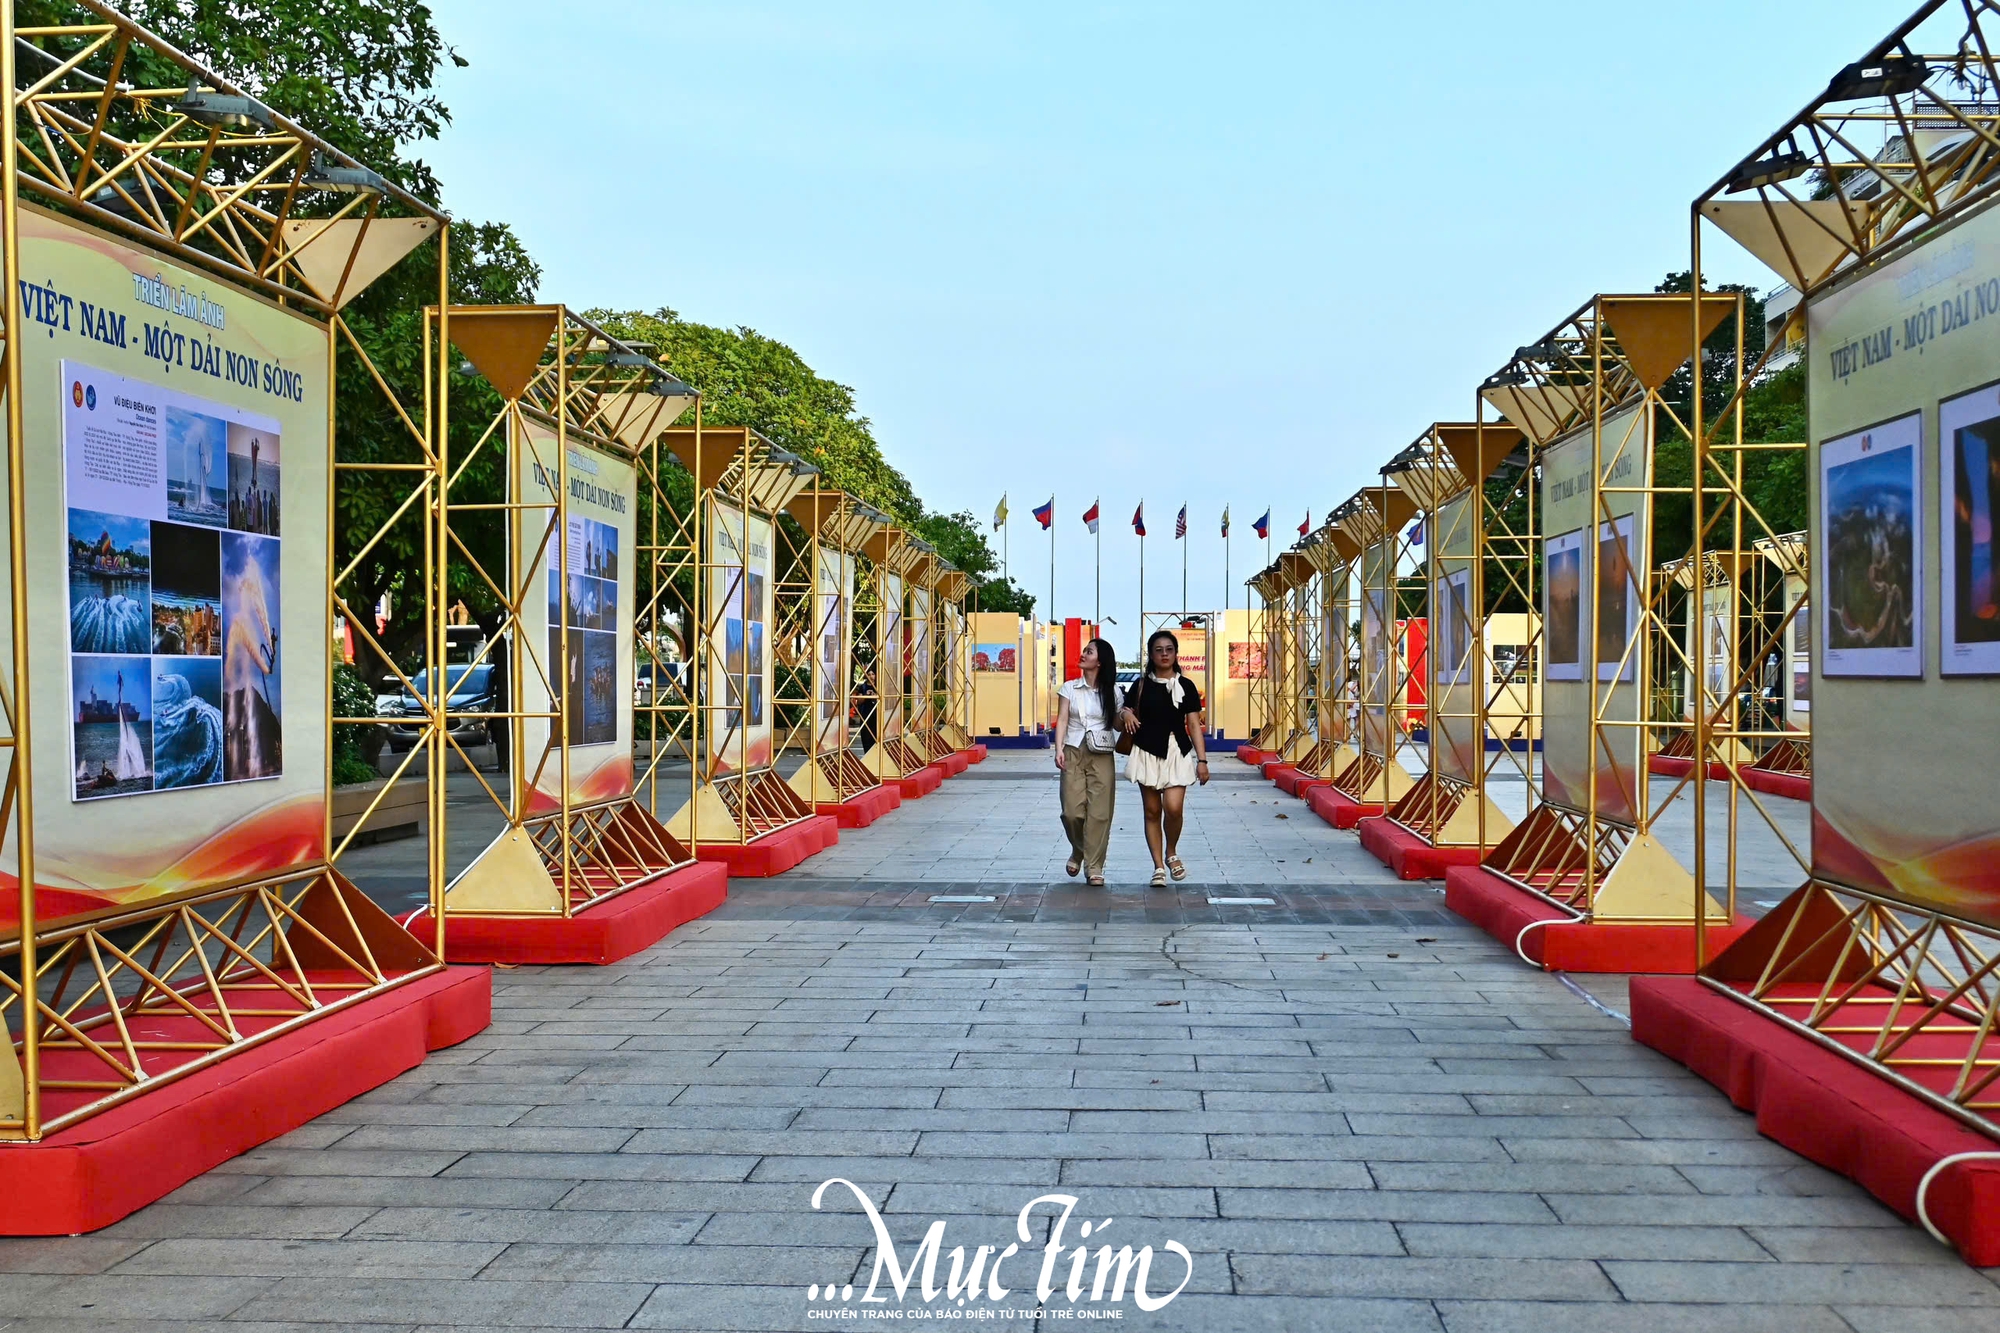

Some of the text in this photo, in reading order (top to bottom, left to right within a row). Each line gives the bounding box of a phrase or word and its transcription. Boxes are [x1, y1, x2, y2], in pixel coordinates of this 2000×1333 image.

[19, 279, 74, 338] VIỆT
[80, 300, 127, 349] NAM
[143, 320, 185, 373] MỘT
[191, 333, 221, 378] DẢI
[225, 349, 259, 389] NON
[263, 358, 303, 403] SÔNG
[133, 272, 225, 330] TRIỂN LÃM ẢNH
[1830, 337, 1860, 386] VIỆT
[1862, 326, 1893, 369] NAM
[1903, 302, 1937, 355] MỘT
[1941, 282, 1970, 335] DẢI
[1974, 277, 2000, 321] NO
